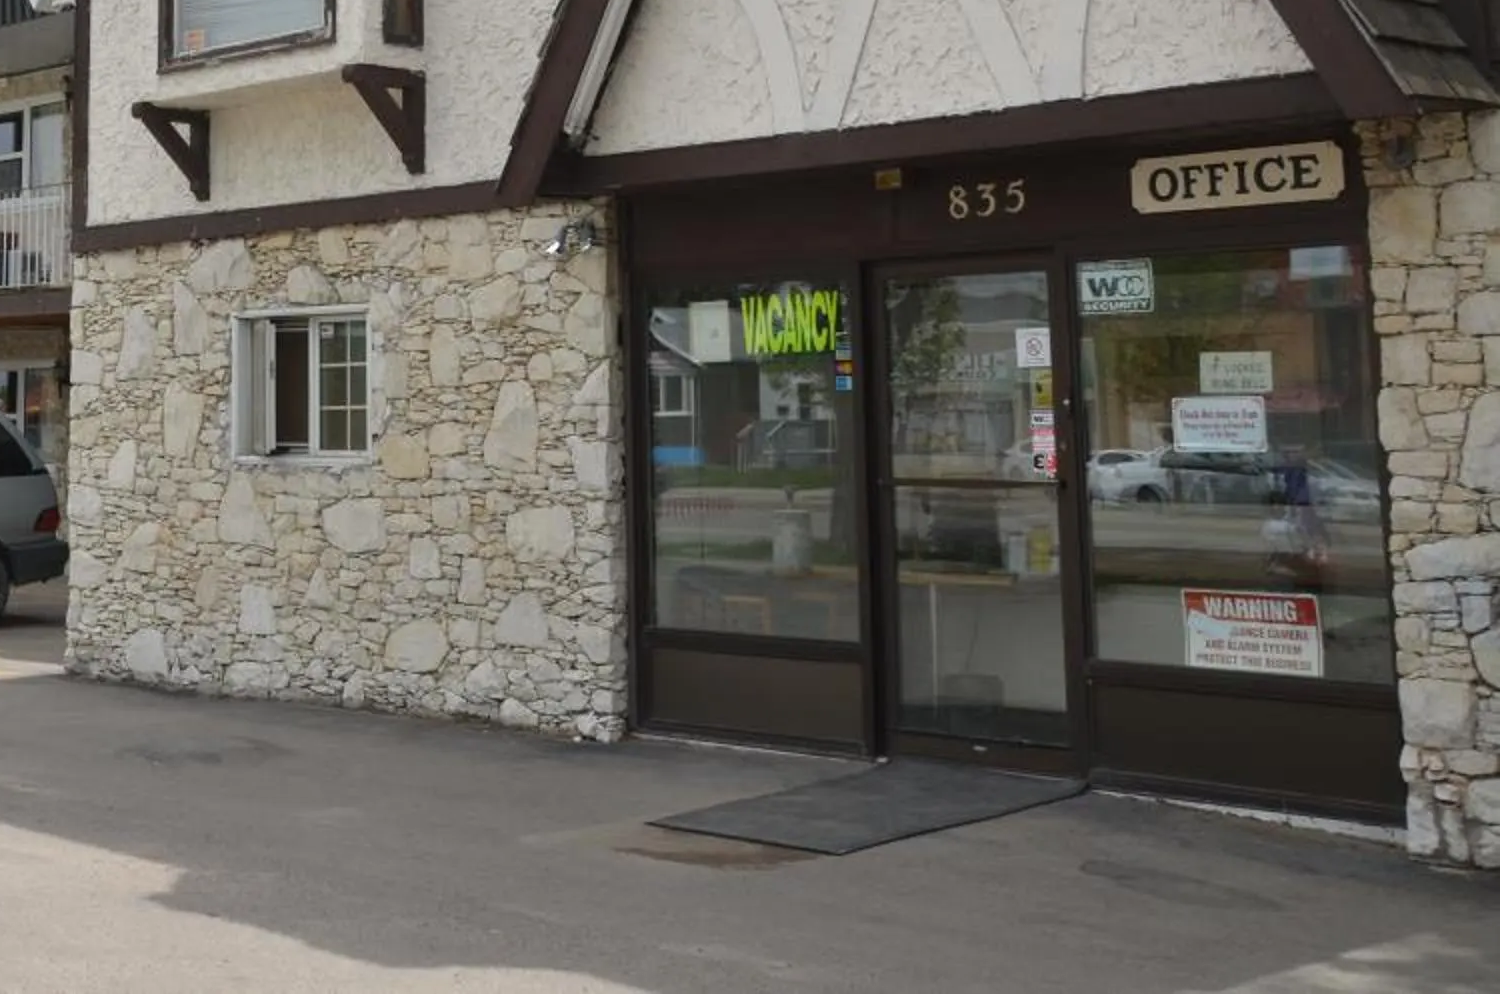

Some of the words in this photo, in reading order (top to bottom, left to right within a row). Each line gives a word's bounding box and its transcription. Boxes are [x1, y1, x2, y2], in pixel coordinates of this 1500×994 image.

[1148, 153, 1322, 202] OFFICE
[948, 179, 1026, 219] 835
[1083, 300, 1151, 312] SECURITY
[740, 290, 838, 355] VACANCY
[1203, 595, 1298, 622] WARNING
[1227, 639, 1261, 652] ALARM
[1262, 642, 1303, 655] SYSTEM
[1267, 627, 1310, 641] CAMERA
